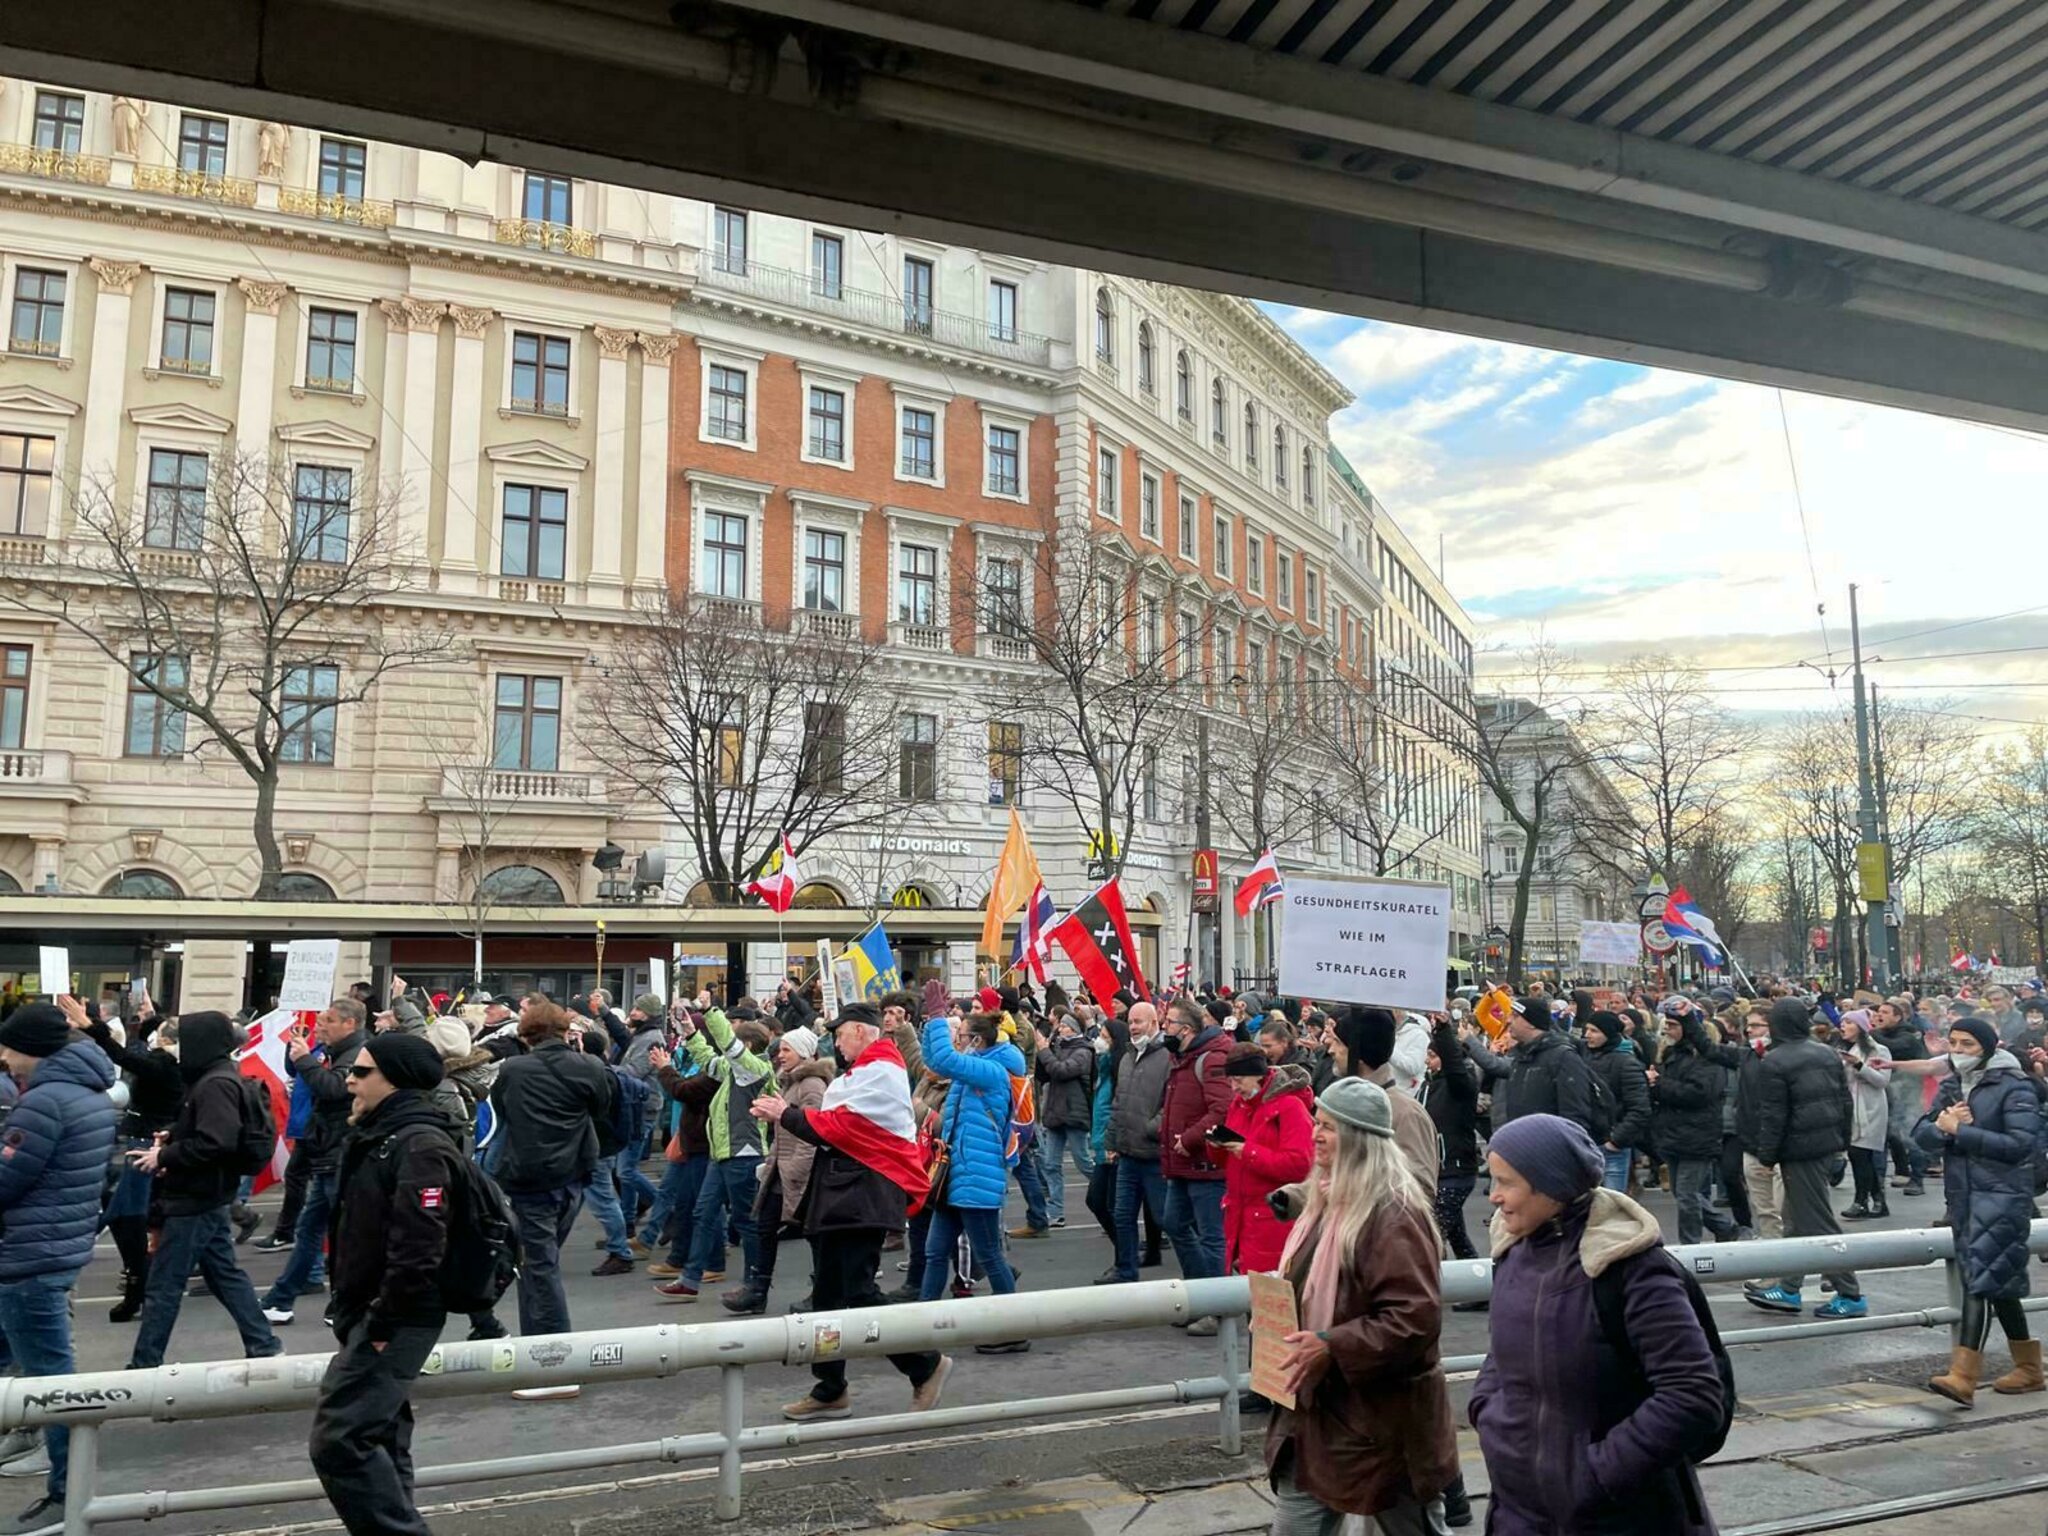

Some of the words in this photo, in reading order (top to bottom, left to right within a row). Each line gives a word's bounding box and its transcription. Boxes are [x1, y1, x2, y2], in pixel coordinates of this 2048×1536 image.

[869, 836, 971, 854] McDonald's
[1294, 896, 1440, 916] GESUNDHEITSKURATEL
[1339, 930, 1364, 942] WIE
[1369, 932, 1386, 943] IM
[1316, 962, 1407, 980] STRAFLAGER
